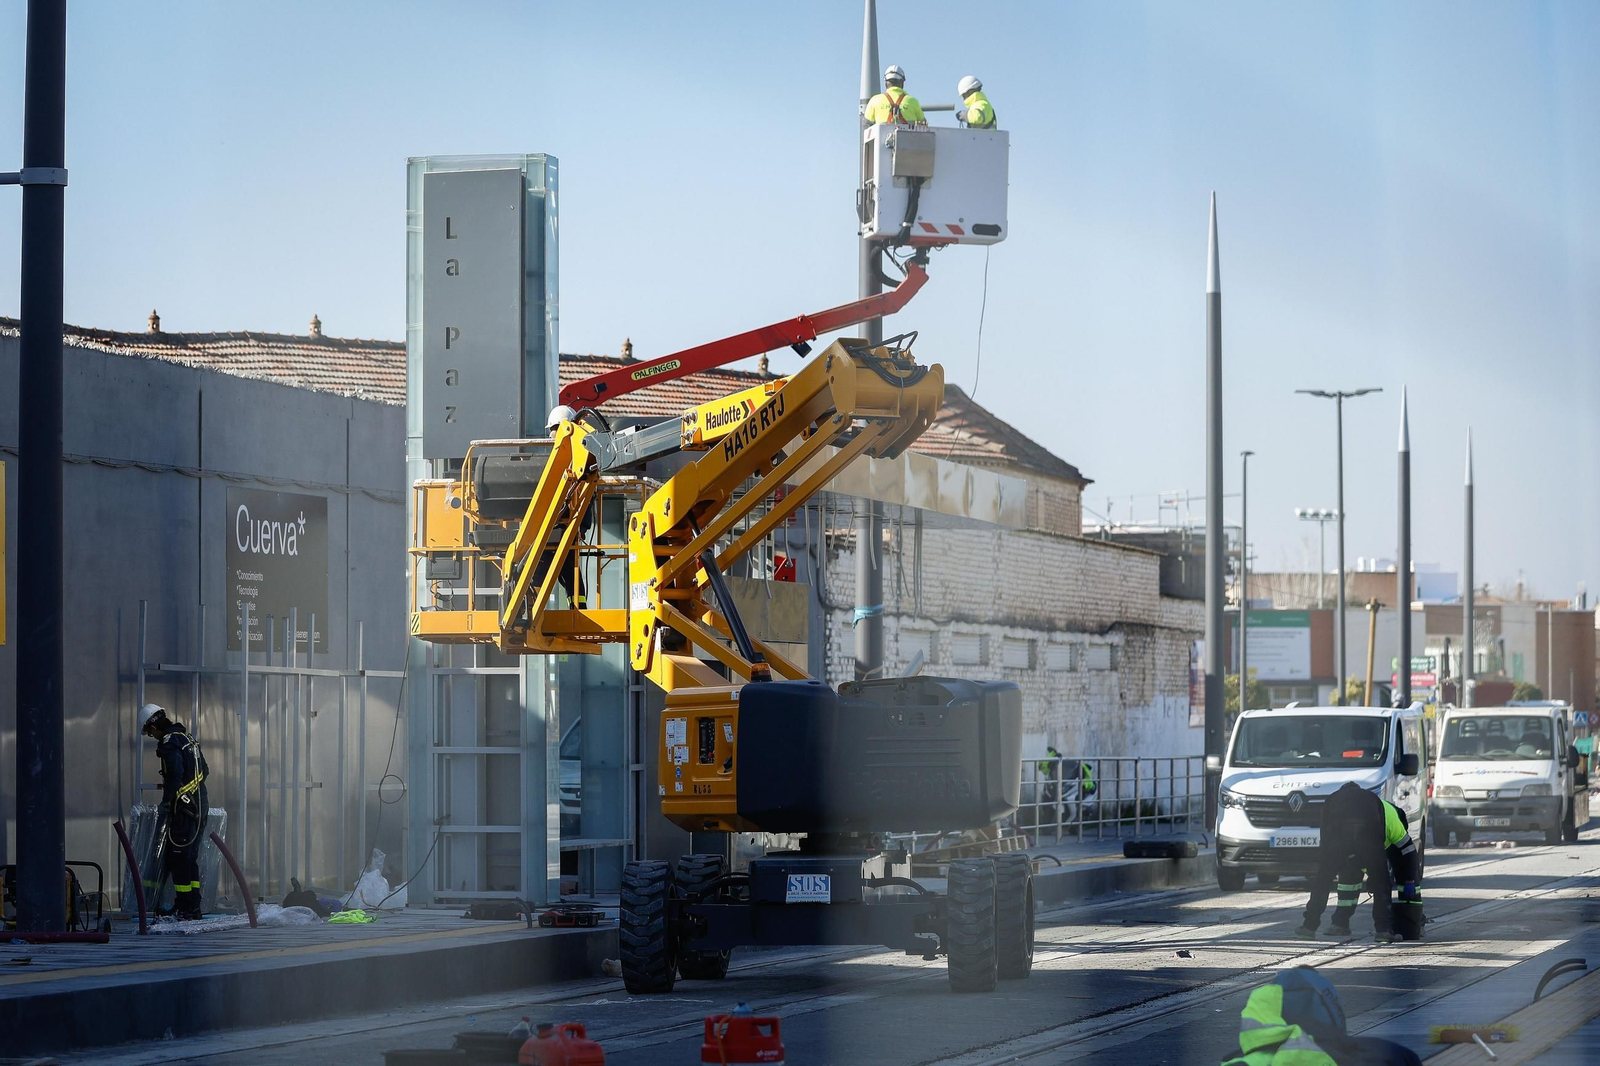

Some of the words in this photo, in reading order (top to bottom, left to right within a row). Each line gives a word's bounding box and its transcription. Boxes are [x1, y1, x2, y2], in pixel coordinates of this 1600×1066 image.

[445, 216, 460, 277] La
[445, 326, 461, 424] Paz
[633, 360, 678, 380] PALFINGER
[705, 405, 741, 431] Haulotte
[723, 417, 758, 463] HA16
[759, 393, 785, 432] RTJ
[1276, 836, 1299, 846] 2966
[1300, 836, 1318, 846] NCX
[790, 875, 827, 892] SOS
